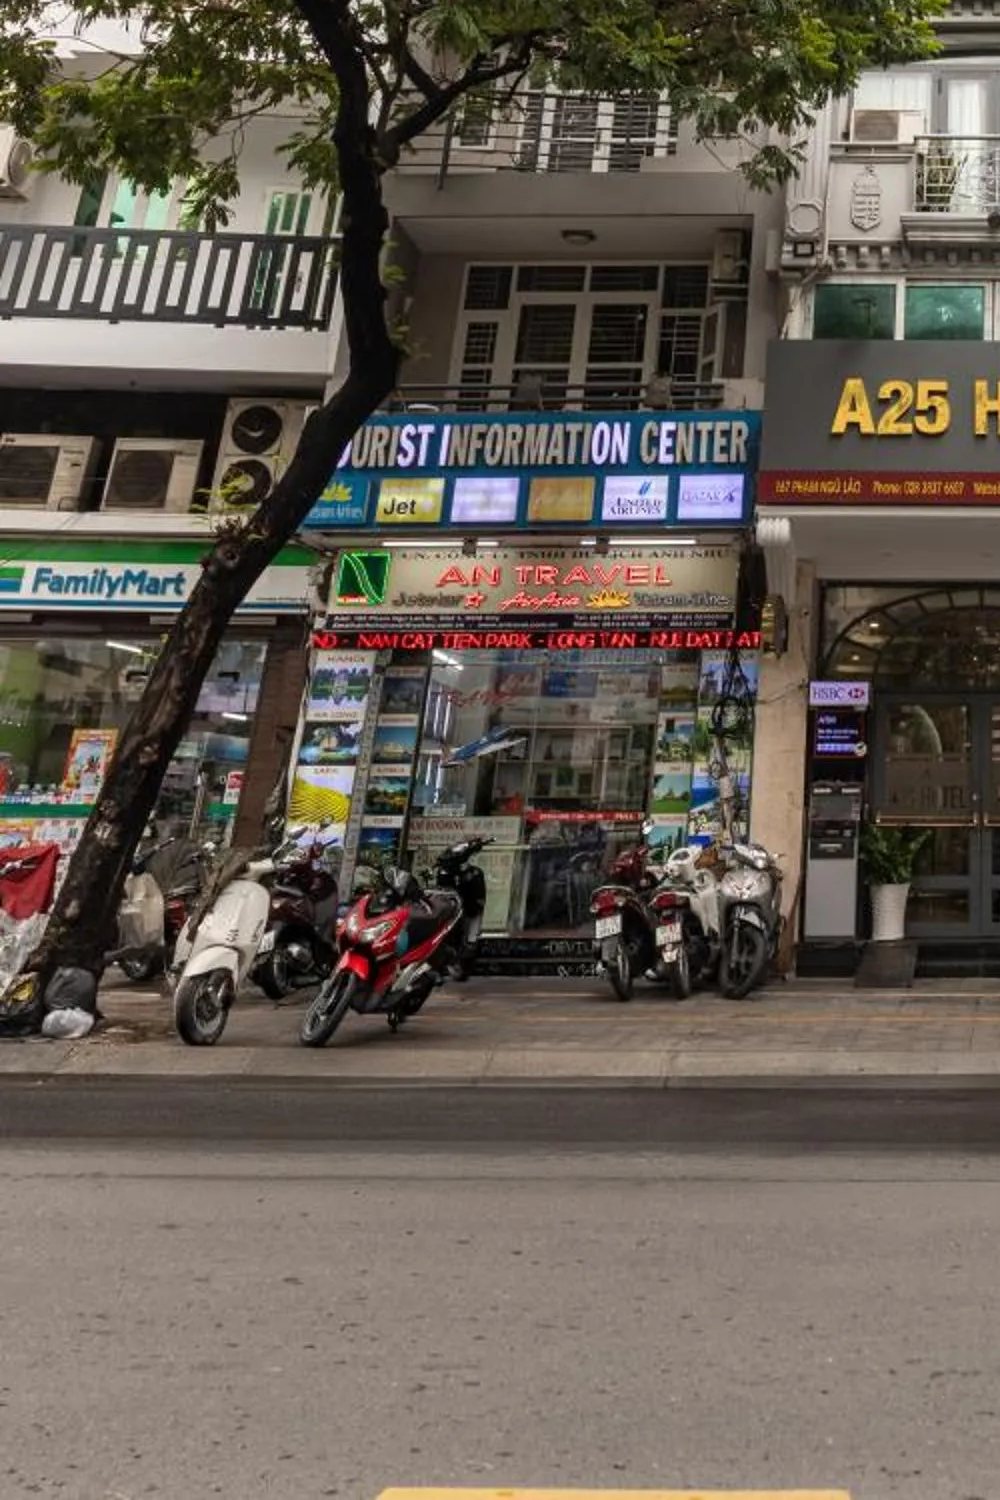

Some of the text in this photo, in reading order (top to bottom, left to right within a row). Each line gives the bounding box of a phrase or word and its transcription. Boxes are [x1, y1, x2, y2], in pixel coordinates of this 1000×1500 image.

[831, 378, 951, 437] A25
[337, 420, 749, 468] URIST INFORMATION CENTER
[31, 567, 186, 598] FamilyMart
[435, 562, 673, 588] AN TRAVEL
[484, 632, 532, 649] PARK
[813, 687, 845, 699] HSBC
